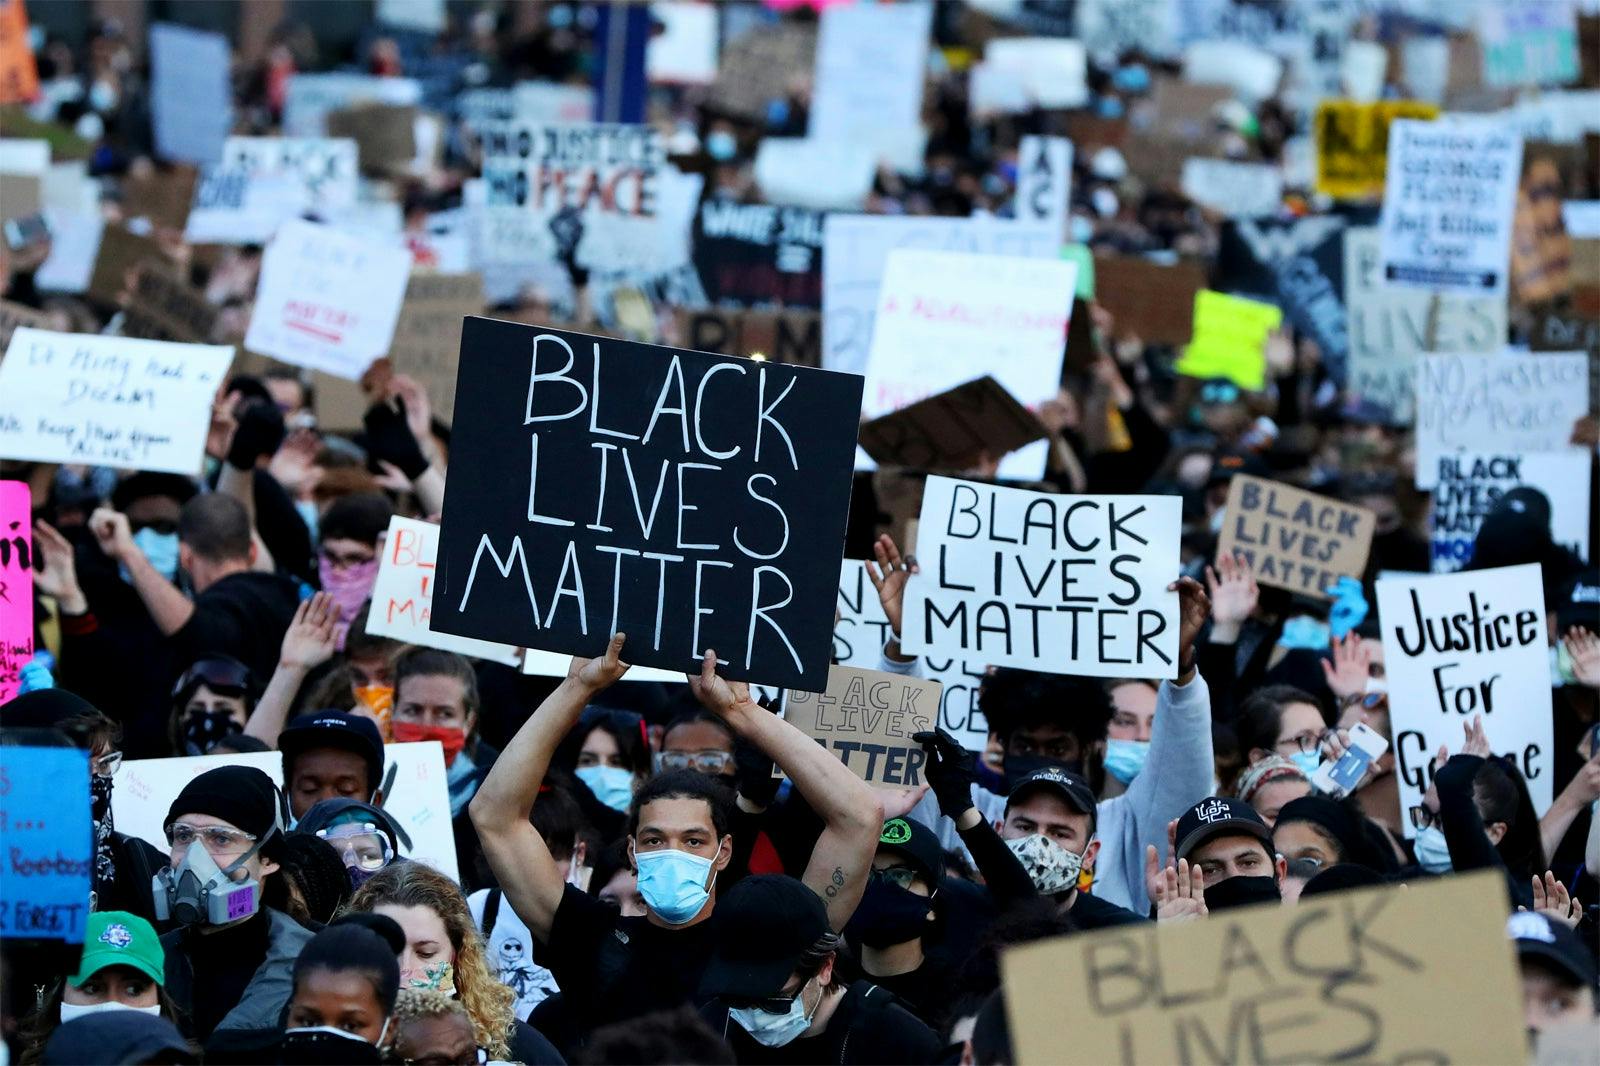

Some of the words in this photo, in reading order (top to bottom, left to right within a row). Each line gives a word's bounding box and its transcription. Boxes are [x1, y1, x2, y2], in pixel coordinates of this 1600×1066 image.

[523, 333, 799, 471] BLACK
[527, 432, 790, 560] LIVES
[1439, 456, 1522, 480] BLACK
[946, 484, 1149, 552] BLACK
[1235, 515, 1341, 561] LIVES
[1240, 480, 1361, 537] BLACK
[939, 545, 1142, 607] LIVES
[1232, 545, 1343, 594] MATTE
[458, 533, 804, 675] MATTER
[923, 597, 1174, 666] MATTER
[1395, 588, 1538, 658] Justice
[1432, 663, 1502, 715] For
[814, 705, 930, 740] LIVES
[1082, 895, 1425, 1016] BLACK
